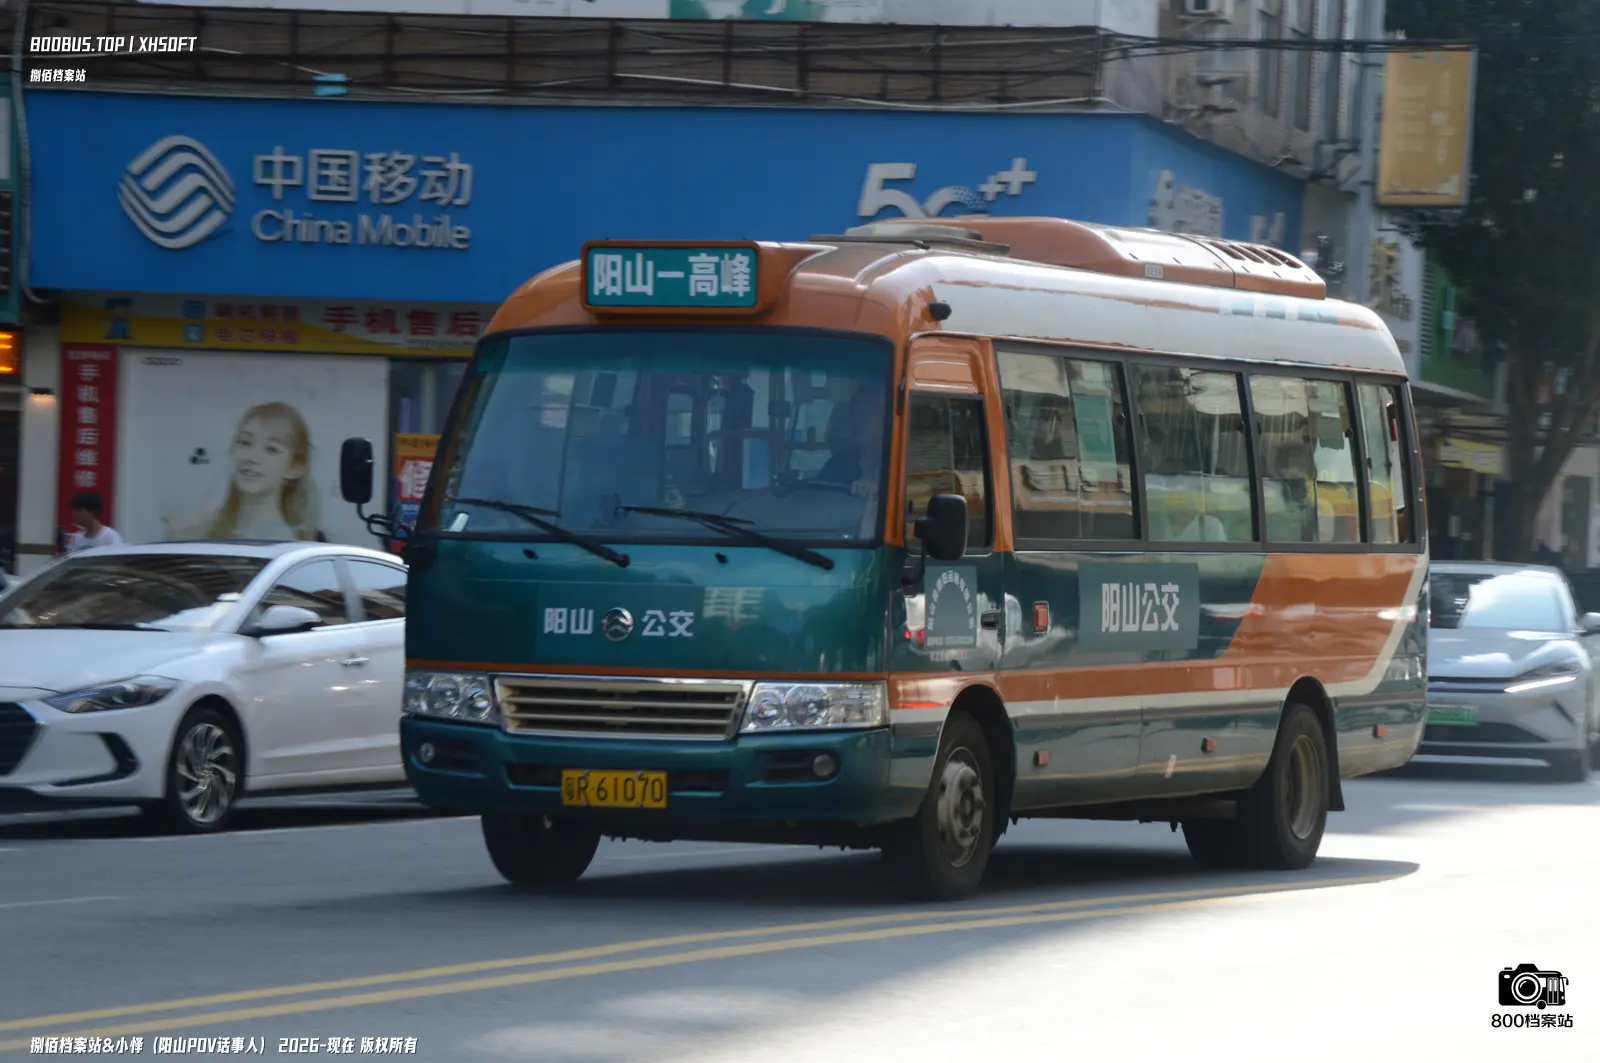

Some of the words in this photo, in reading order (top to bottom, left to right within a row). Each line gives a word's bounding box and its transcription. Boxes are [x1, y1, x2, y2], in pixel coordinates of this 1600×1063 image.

[253, 145, 473, 206] 中国移动
[252, 208, 353, 244] China
[358, 213, 472, 249] Mobile
[543, 607, 594, 635] 阳山
[641, 610, 695, 637] 公交
[1101, 582, 1180, 632] 阳山公交
